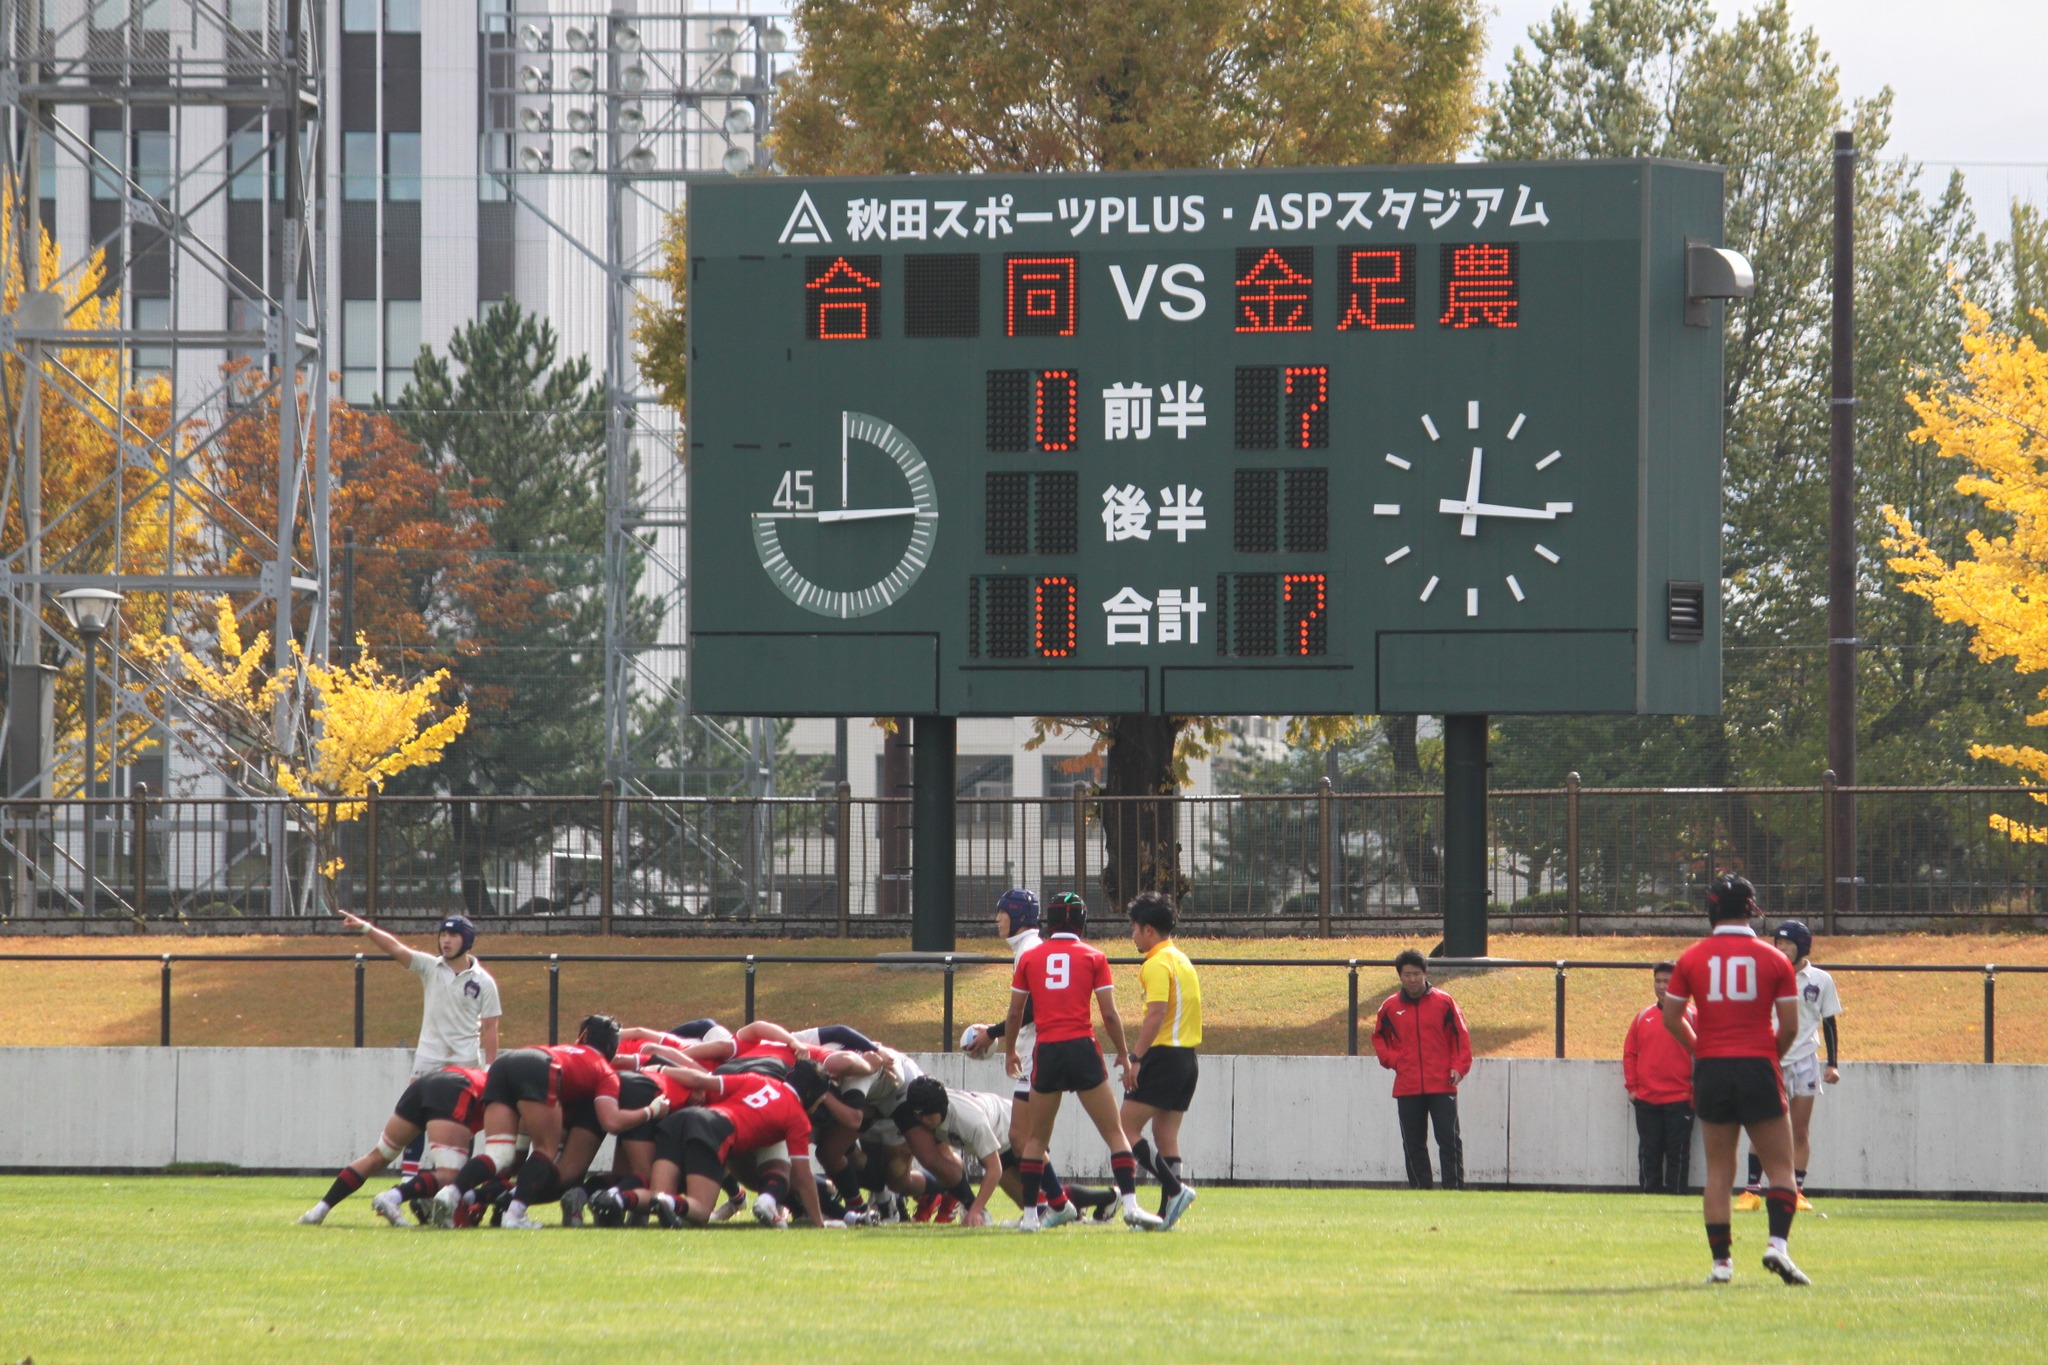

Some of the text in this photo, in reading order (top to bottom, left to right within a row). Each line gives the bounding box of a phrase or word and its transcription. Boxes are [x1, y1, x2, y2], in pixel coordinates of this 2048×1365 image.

[1108, 263, 1207, 321] VS
[1235, 244, 1519, 333] 金足農
[1036, 370, 1076, 451] 0
[1102, 380, 1207, 440] 前半
[1285, 366, 1327, 448] 7
[773, 470, 813, 510] 45
[1101, 483, 1207, 543] 後半
[1035, 577, 1076, 657] 0
[1102, 586, 1207, 646] 合計
[1284, 574, 1326, 655] 7
[1045, 953, 1070, 990] 9
[1707, 955, 1757, 1002] 10
[743, 1084, 781, 1109] 6
